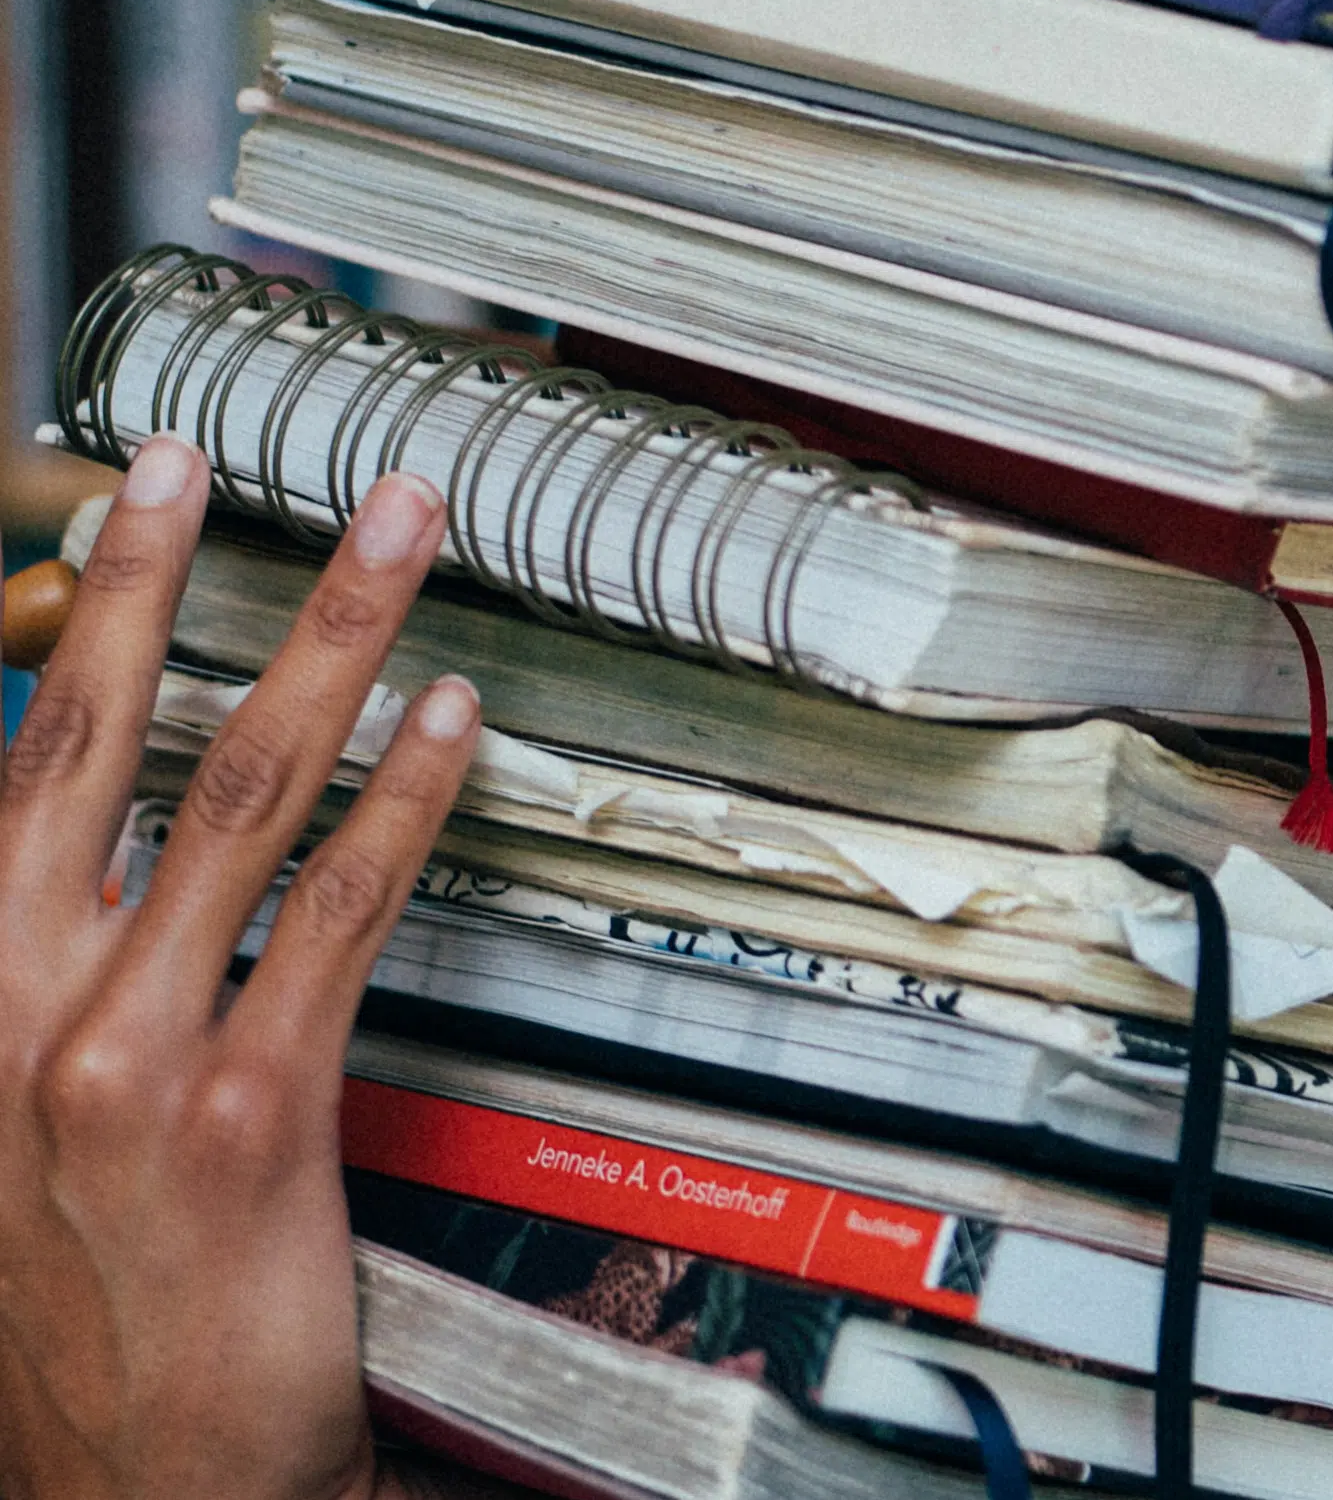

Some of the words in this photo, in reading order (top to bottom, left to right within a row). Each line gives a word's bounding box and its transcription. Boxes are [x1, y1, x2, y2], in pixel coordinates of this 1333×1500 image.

[527, 1137, 622, 1184] Jenneke
[624, 1159, 649, 1192] A.
[658, 1164, 791, 1221] Oosterhoff
